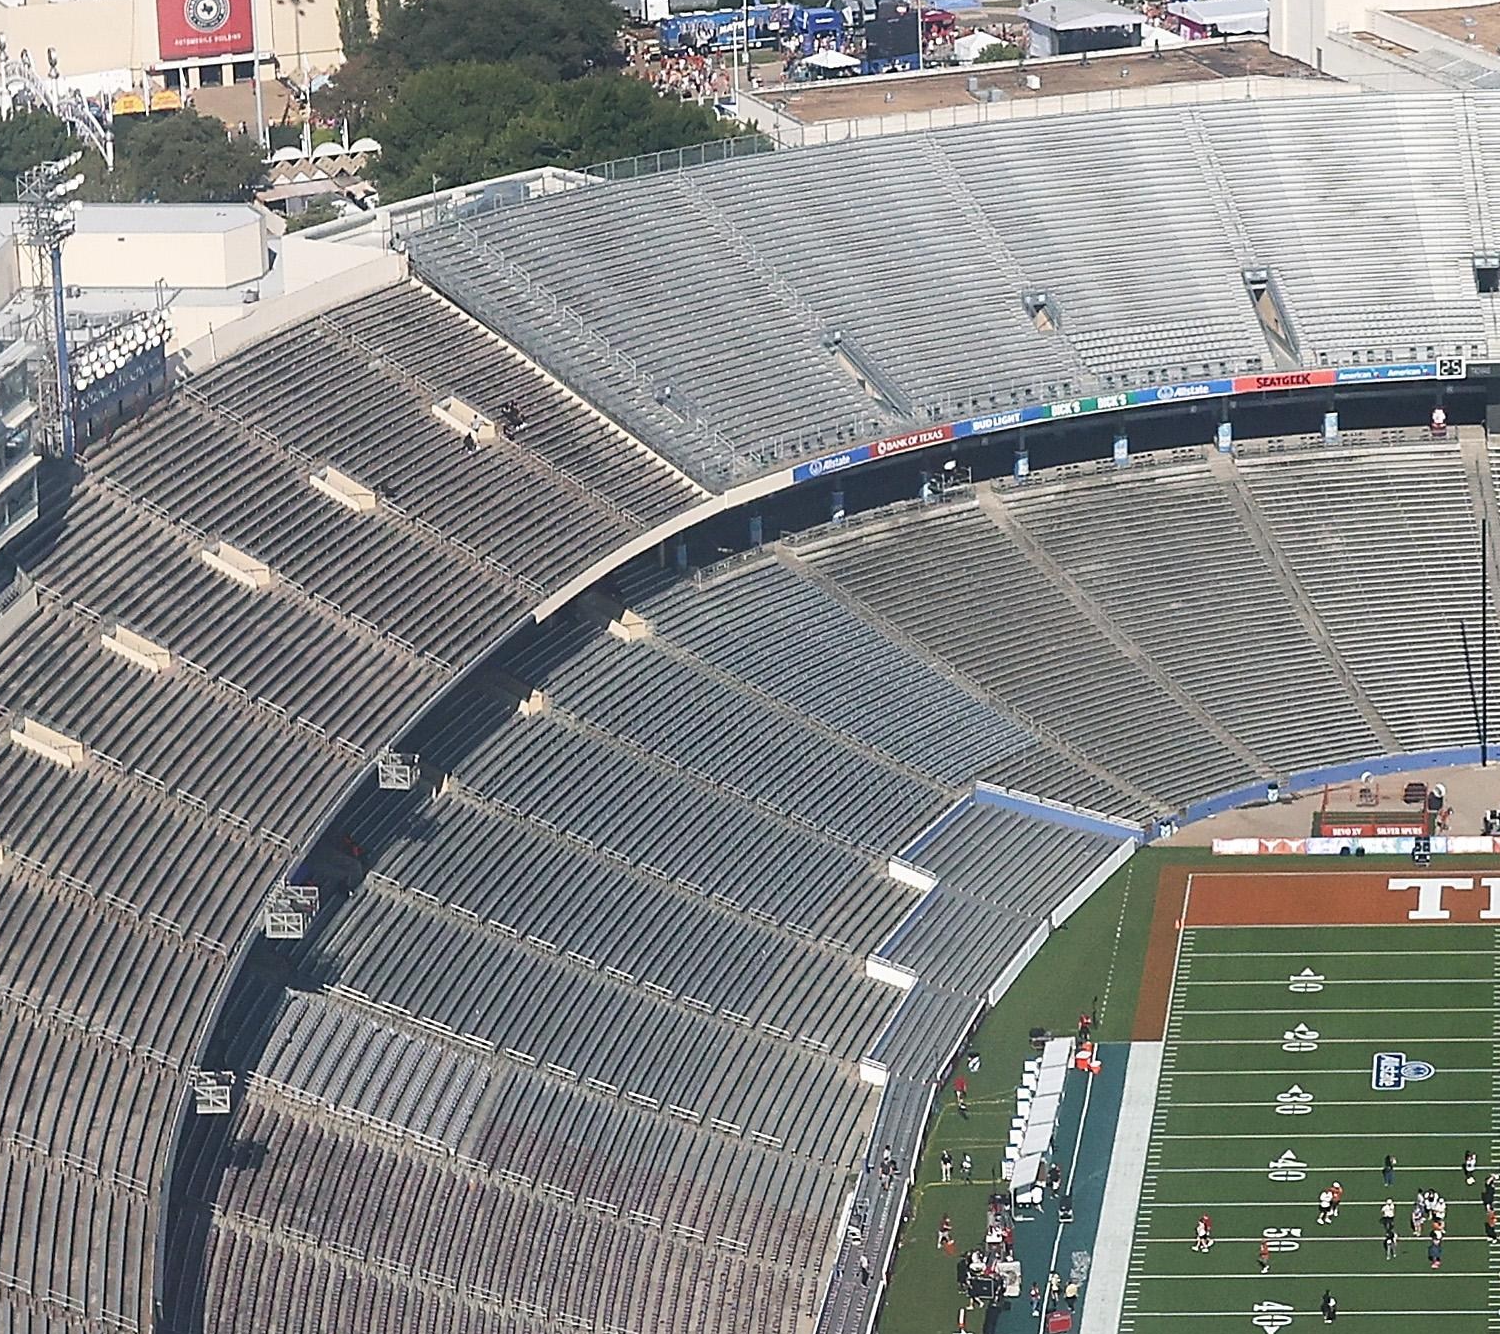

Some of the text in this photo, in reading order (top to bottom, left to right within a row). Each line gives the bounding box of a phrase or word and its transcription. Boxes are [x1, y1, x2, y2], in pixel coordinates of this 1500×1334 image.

[1441, 360, 1461, 375] 25
[1174, 384, 1209, 397] Allstate
[1257, 373, 1311, 389] SEATGEEK
[972, 413, 1021, 432] BUD LIGHT
[886, 429, 943, 452] BANK OF TEXAS
[1289, 975, 1325, 992] 10
[1282, 1030, 1319, 1052] 20
[1380, 1056, 1401, 1088] Allstate
[1276, 1093, 1313, 1114] 30
[1268, 1160, 1308, 1181] 40
[1262, 1227, 1301, 1252] 50
[1252, 1301, 1294, 1327] 40
